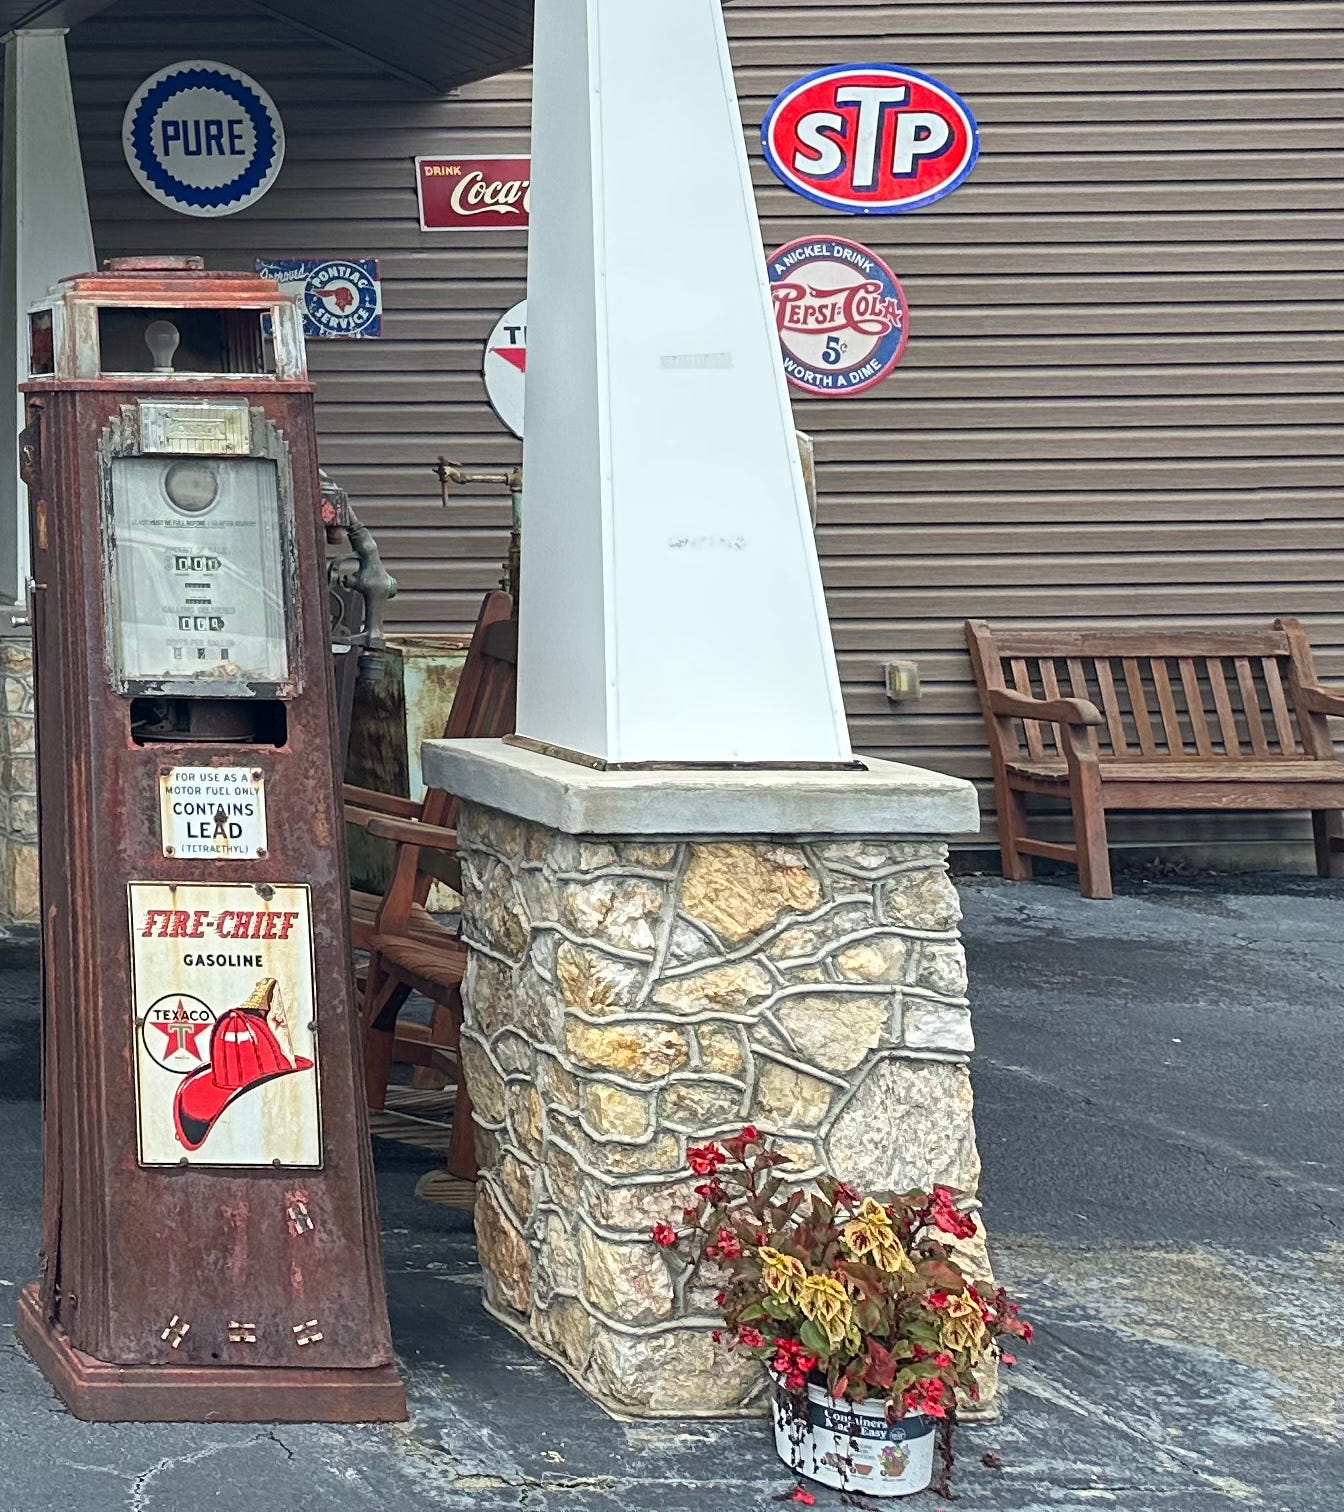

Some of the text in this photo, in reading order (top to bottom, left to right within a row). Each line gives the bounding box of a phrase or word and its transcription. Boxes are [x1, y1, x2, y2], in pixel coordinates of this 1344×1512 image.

[161, 119, 246, 157] PURE
[793, 85, 955, 192] STP
[424, 165, 462, 177] DRINK
[450, 170, 530, 216] Coca-
[774, 244, 875, 276] A NICKEL DRINK
[312, 266, 369, 288] PONTIAC
[314, 307, 370, 329] SERVICE
[783, 357, 882, 387] WORTH A DIME
[175, 772, 248, 782] FOR USE AS A
[165, 786, 260, 796] MOTOR FUEL ONLY
[173, 802, 254, 816] CONTAINS
[187, 821, 243, 839] LEAD
[181, 844, 249, 854] (TETRAETHYL)
[141, 909, 299, 940] FIRE-CHIEF
[183, 953, 264, 967] GASOLINE
[153, 1009, 210, 1021] TEXACO
[861, 1427, 888, 1439] Easy
